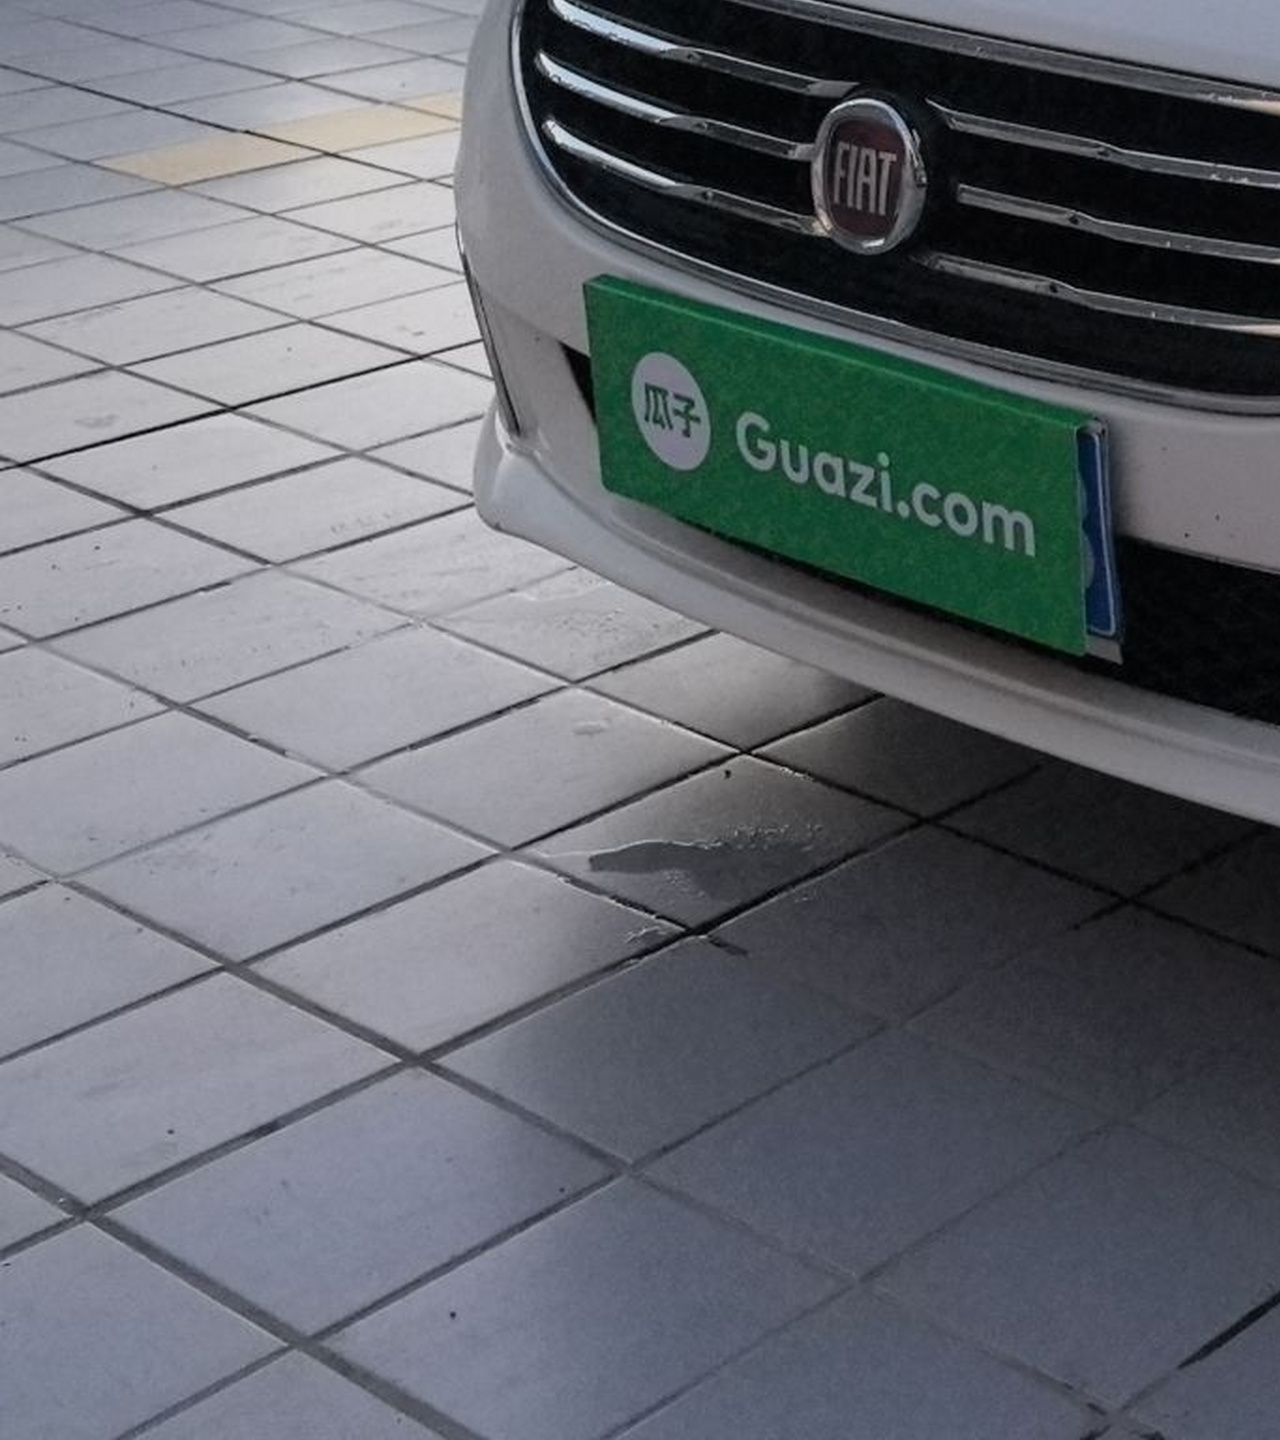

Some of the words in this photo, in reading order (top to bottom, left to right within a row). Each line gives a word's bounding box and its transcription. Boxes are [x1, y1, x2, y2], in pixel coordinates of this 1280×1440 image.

[833, 141, 897, 216] FIAT
[644, 382, 700, 438] 瓜子
[736, 411, 1037, 558] Guazi.com
